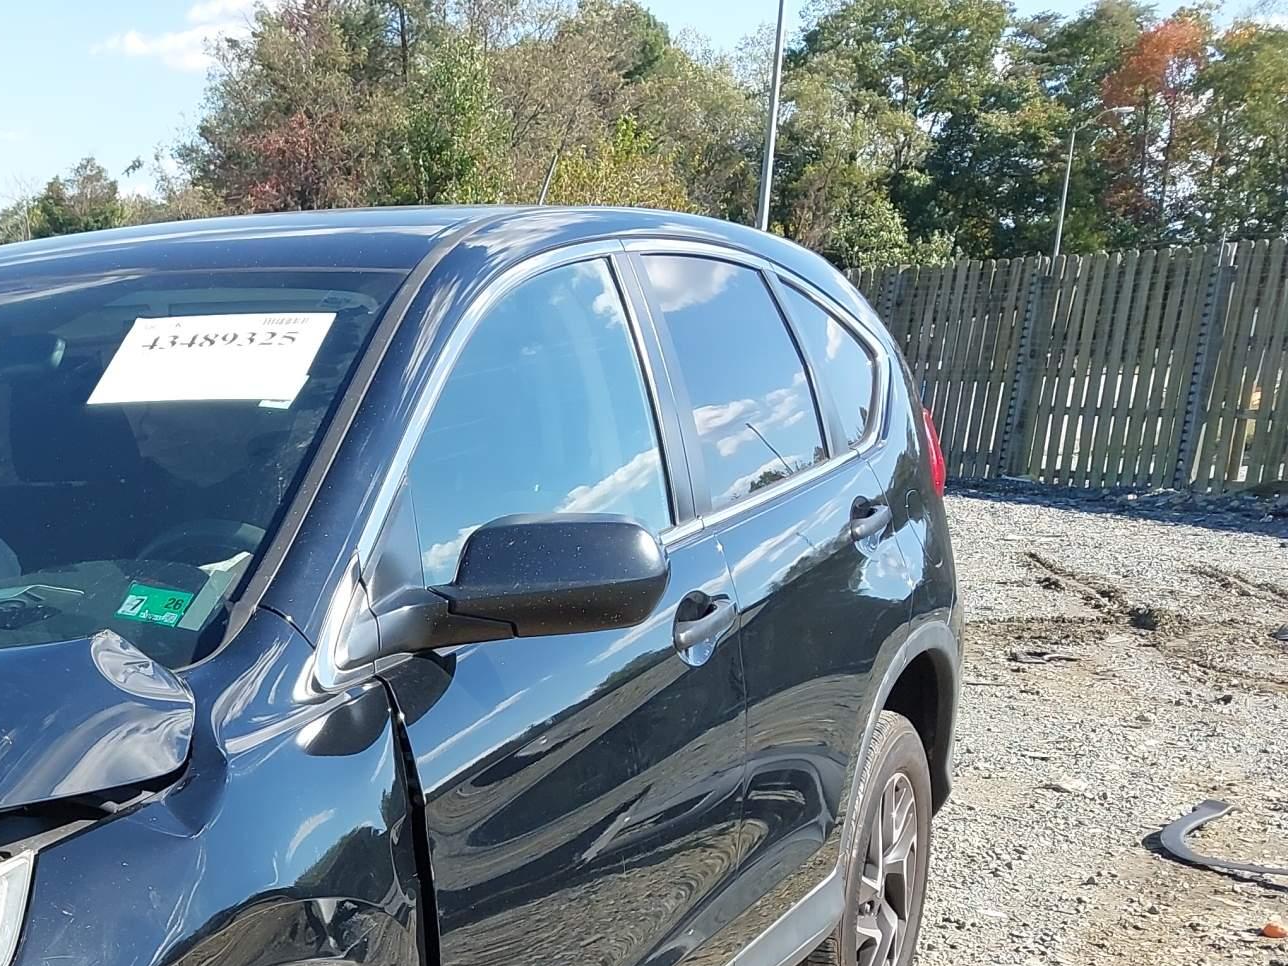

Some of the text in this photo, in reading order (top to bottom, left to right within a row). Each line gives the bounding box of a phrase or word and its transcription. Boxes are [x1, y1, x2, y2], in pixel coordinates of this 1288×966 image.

[141, 330, 300, 350] 43489325
[130, 597, 184, 611] 7 26
